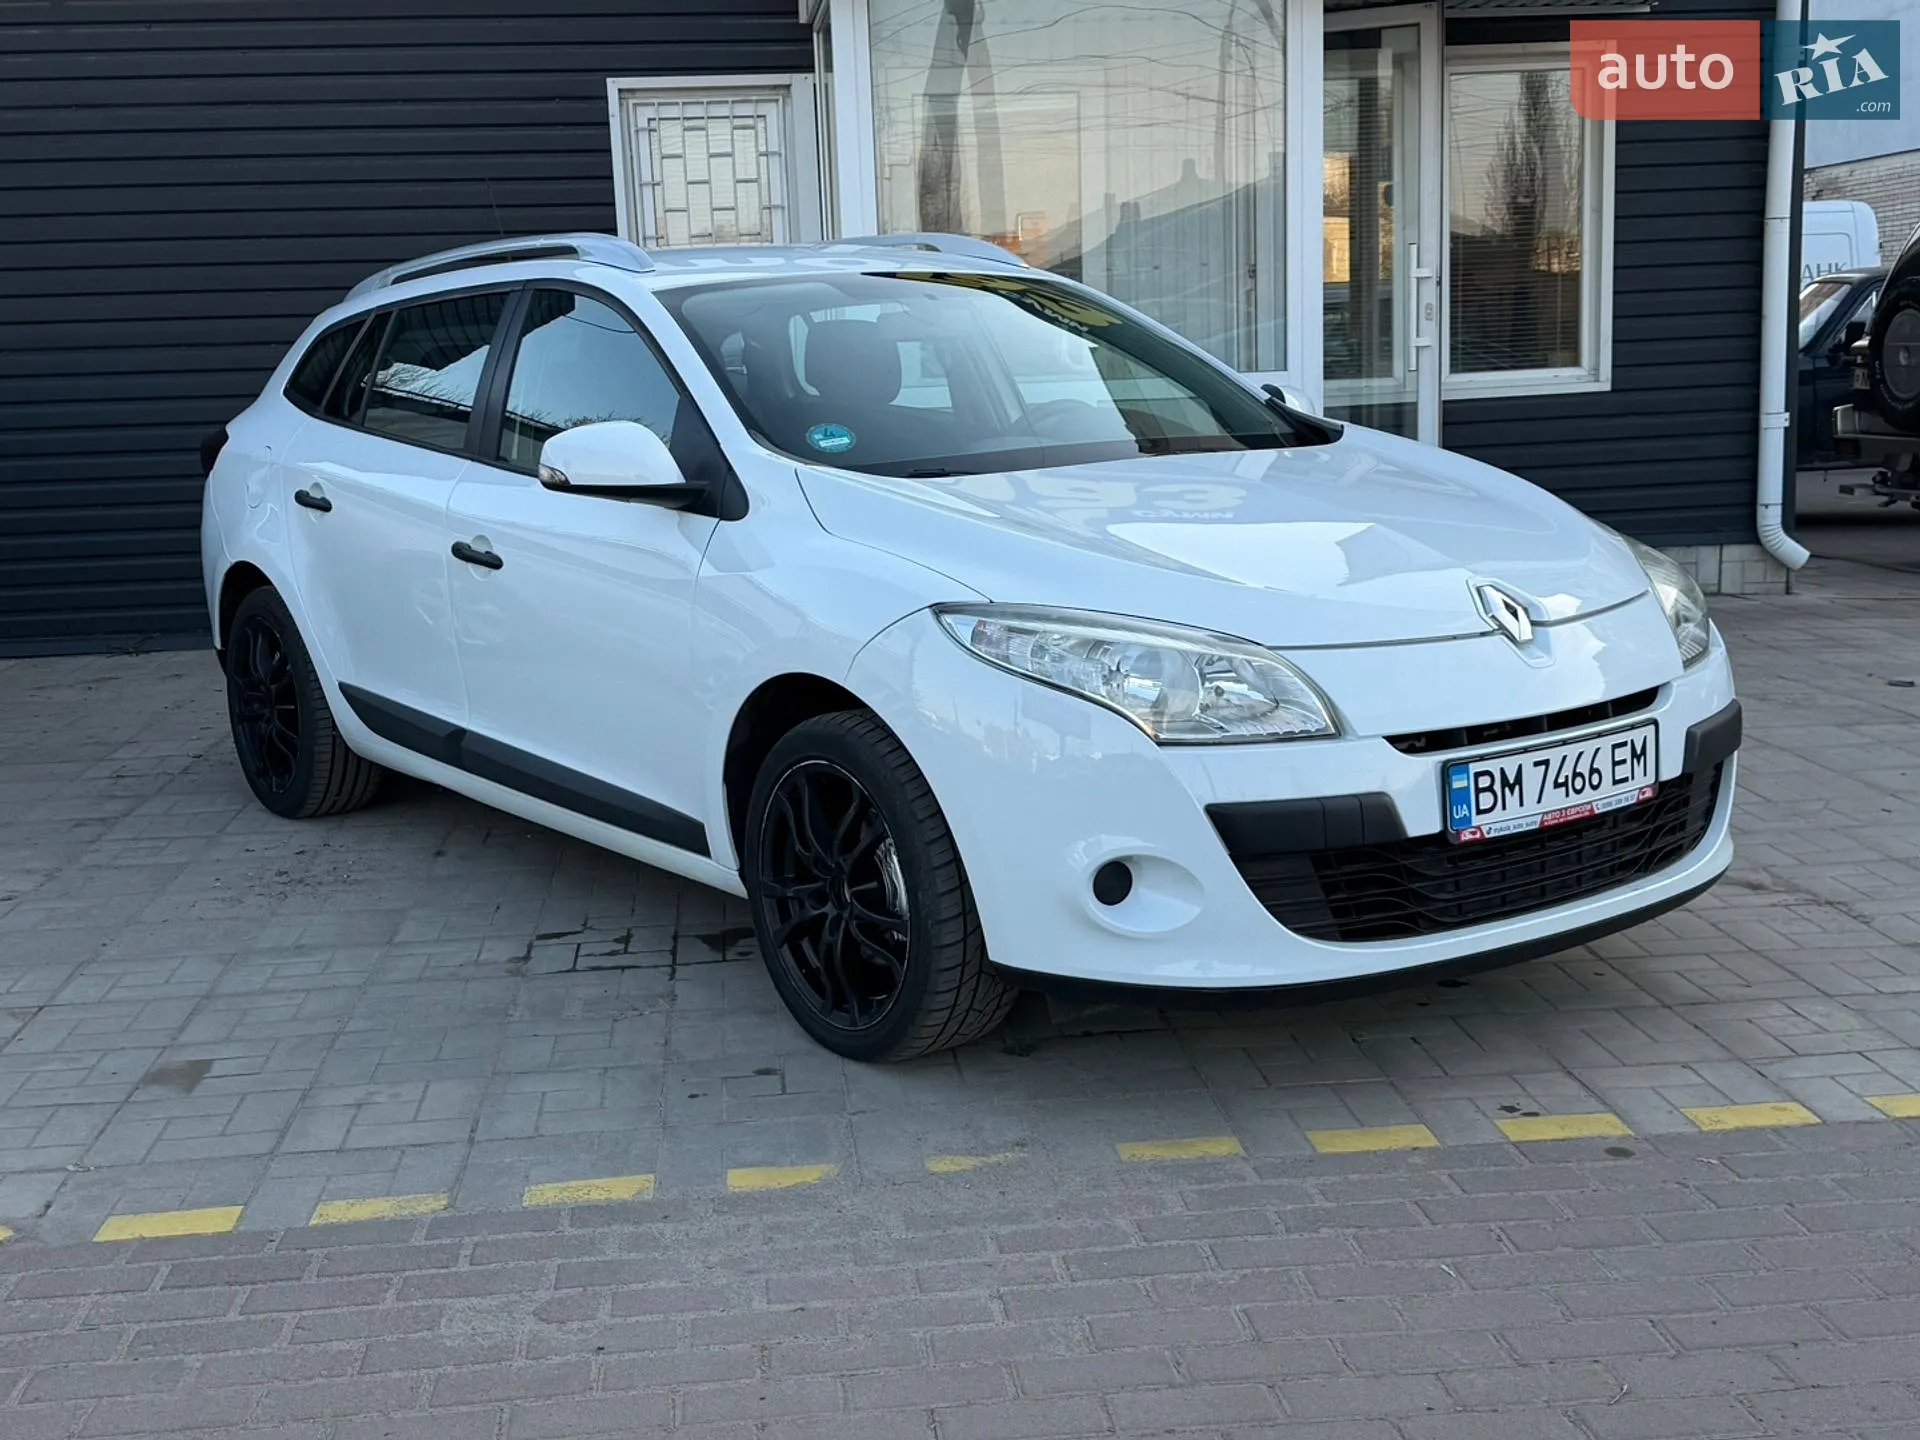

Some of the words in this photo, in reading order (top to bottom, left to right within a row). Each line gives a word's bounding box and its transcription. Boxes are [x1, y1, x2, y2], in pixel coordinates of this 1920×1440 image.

[1473, 763, 1525, 816] BM
[1533, 746, 1603, 804] 7466
[1611, 735, 1648, 786] EM
[1453, 804, 1470, 819] UA
